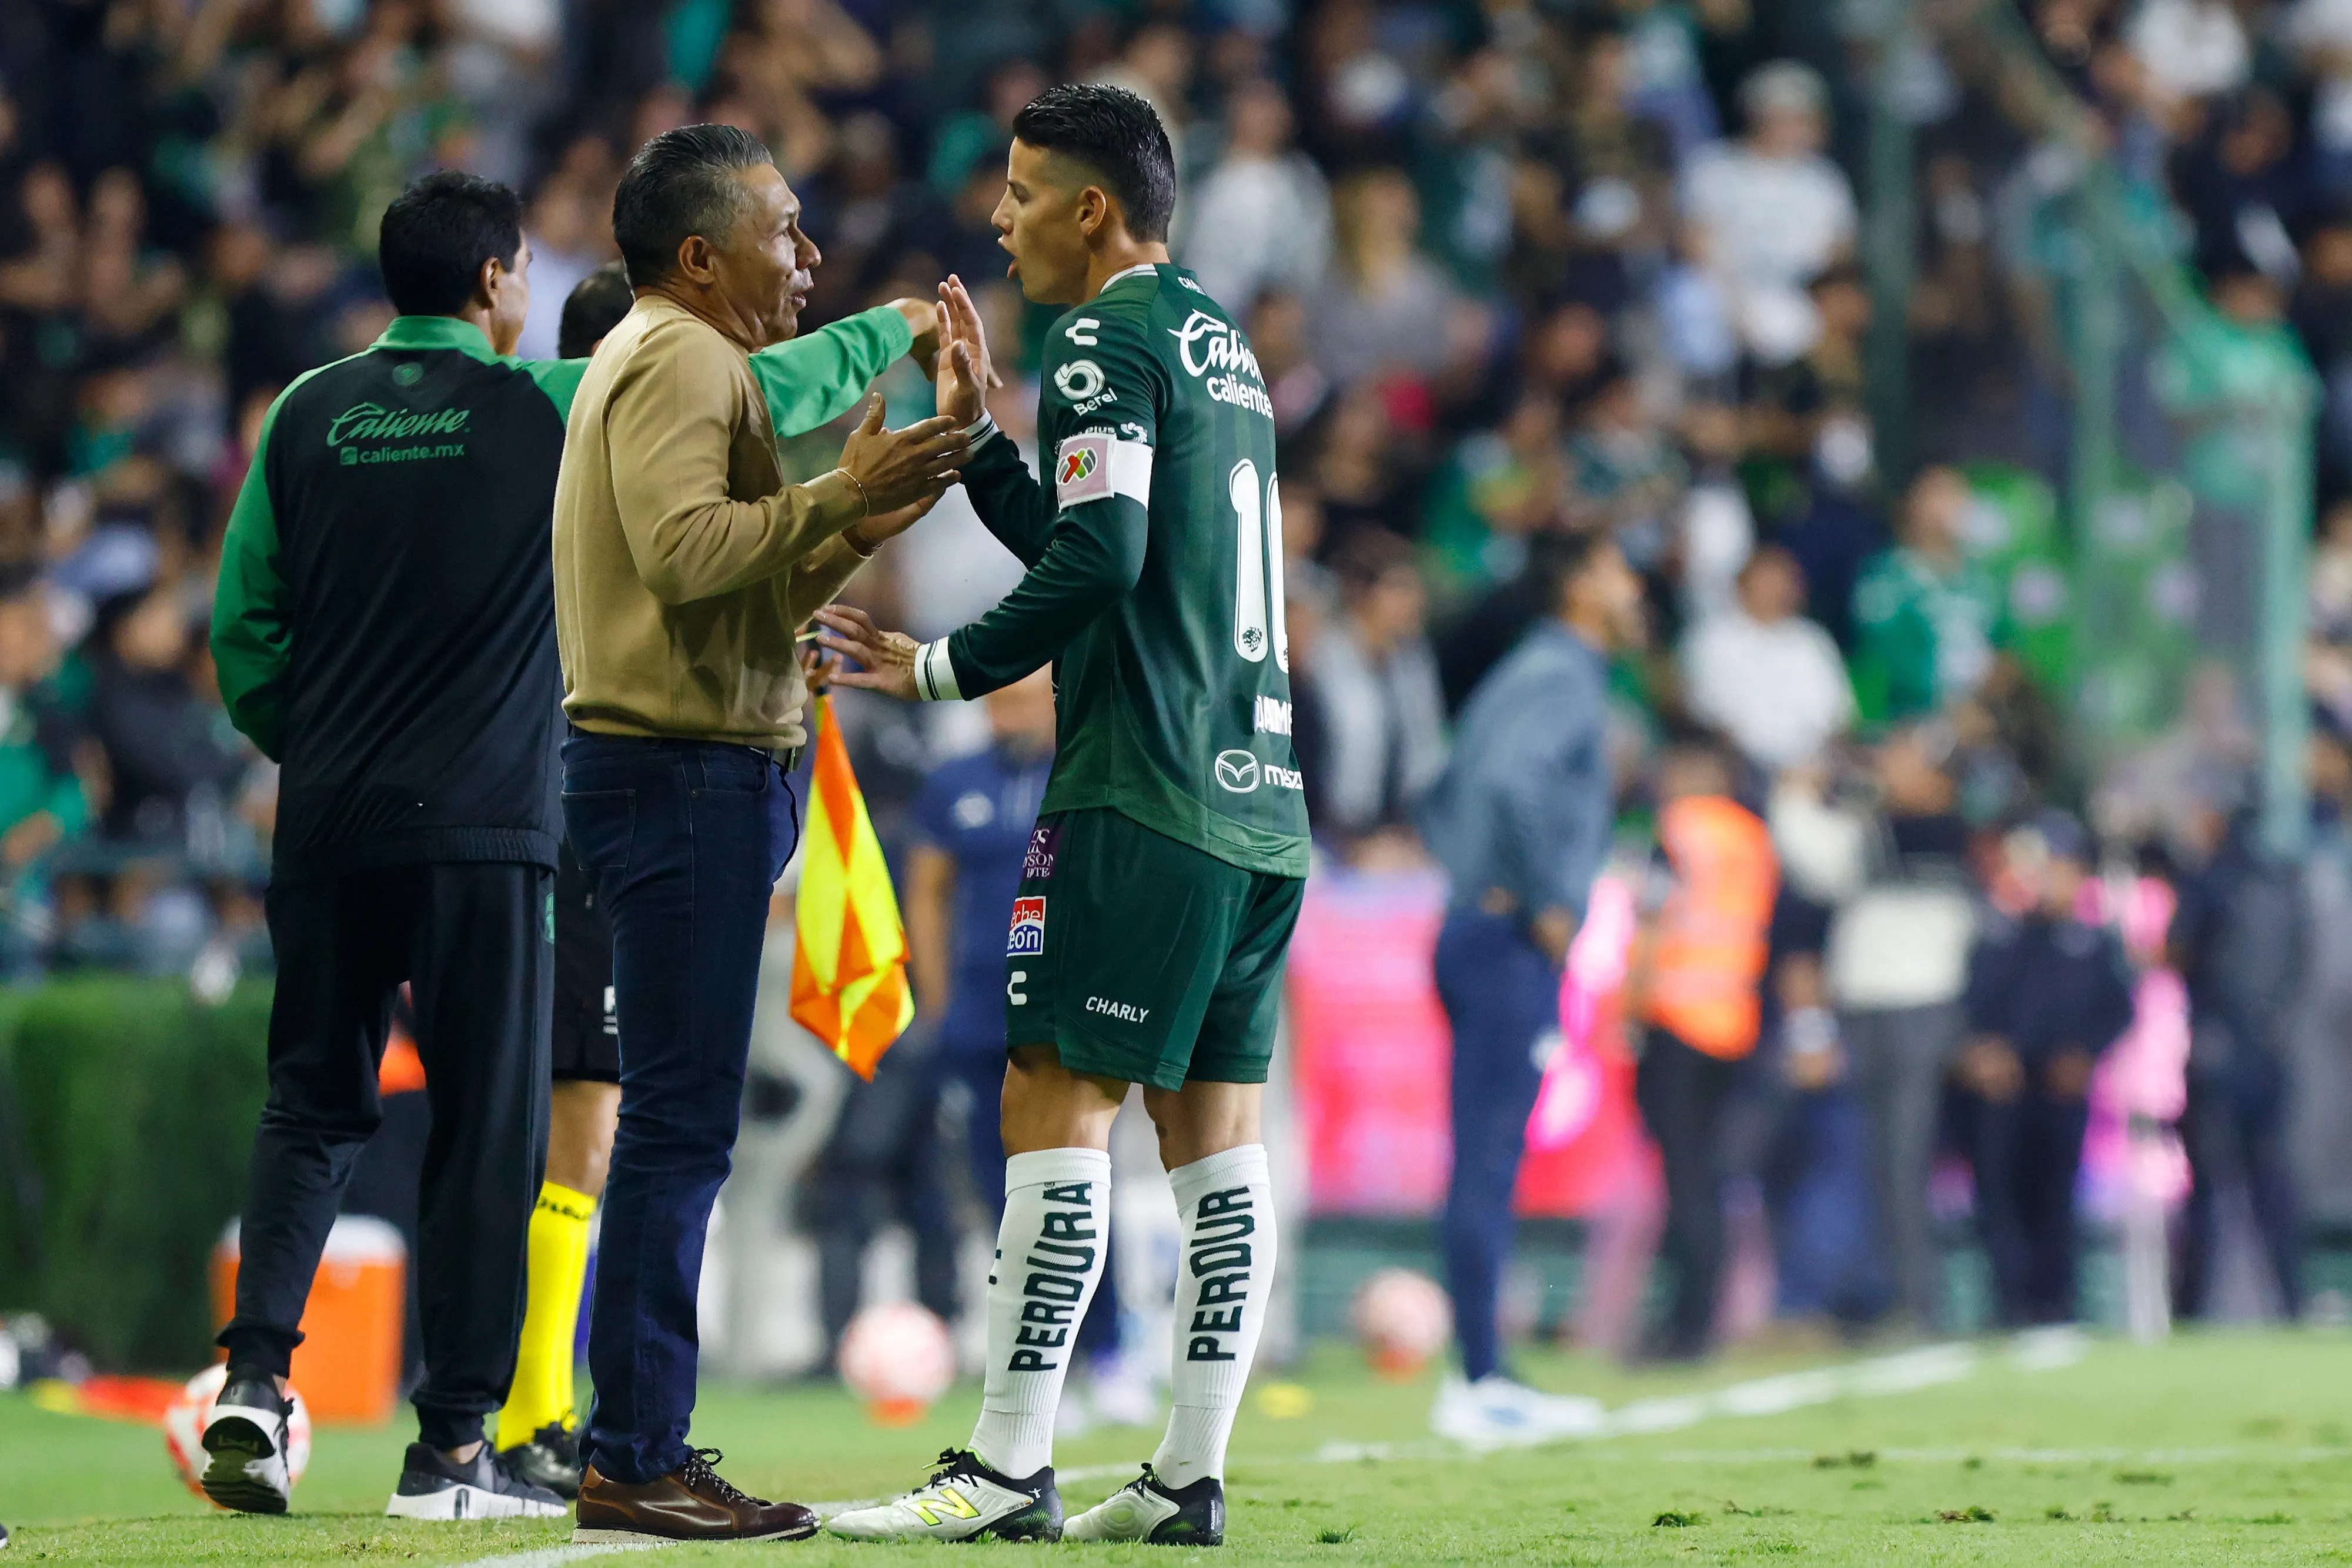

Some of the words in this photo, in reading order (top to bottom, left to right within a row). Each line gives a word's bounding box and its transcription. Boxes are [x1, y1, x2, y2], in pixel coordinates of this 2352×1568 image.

[1073, 387, 1118, 416] Berel
[326, 402, 470, 447] Caliente
[360, 444, 465, 463] caliente.mx
[1085, 996, 1149, 1024] CHARLY
[1008, 1182, 1097, 1372] PERDURA
[1187, 1185, 1255, 1362] PERDUR
